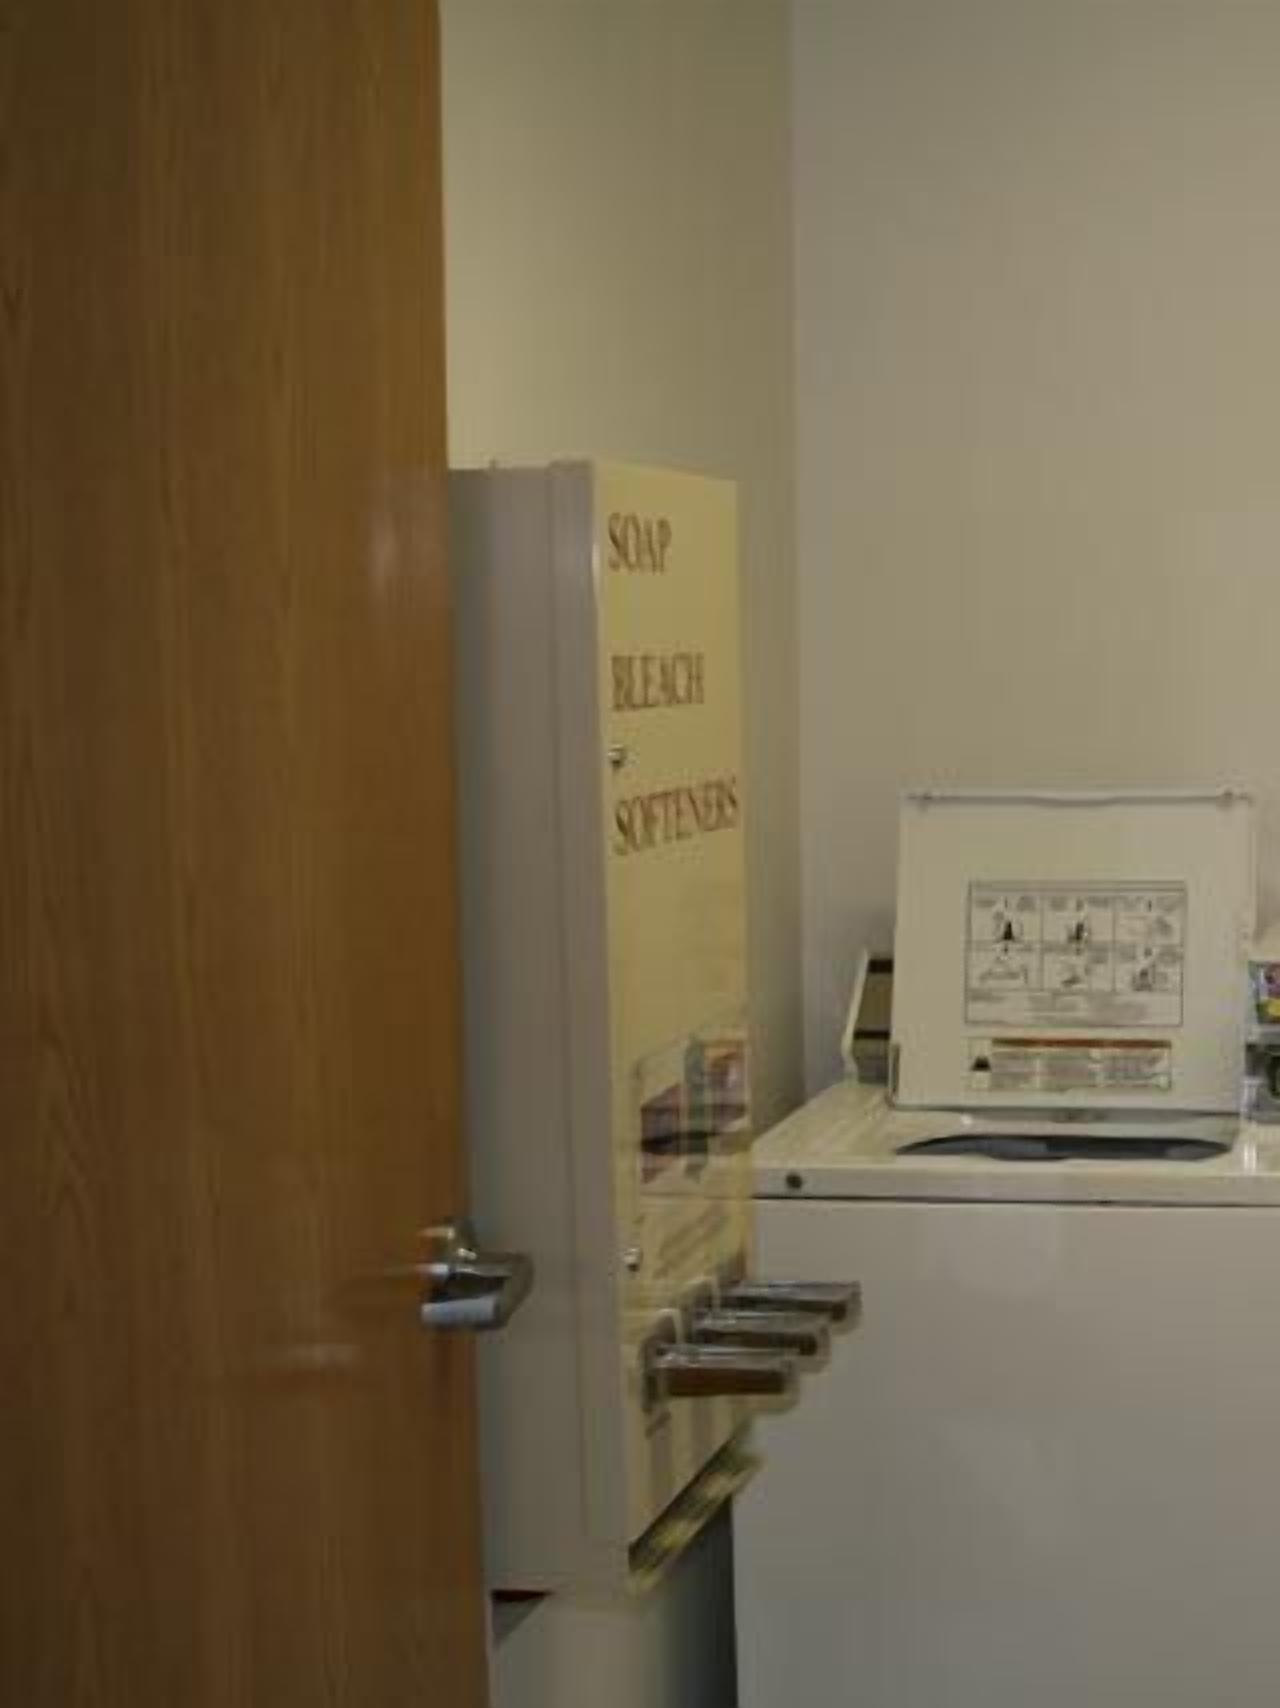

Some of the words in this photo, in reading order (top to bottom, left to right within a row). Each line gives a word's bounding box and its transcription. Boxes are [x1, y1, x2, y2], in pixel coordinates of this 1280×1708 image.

[607, 511, 672, 574] SOAP
[610, 652, 705, 712] BLEACH
[613, 775, 739, 856] SOFTENERS
